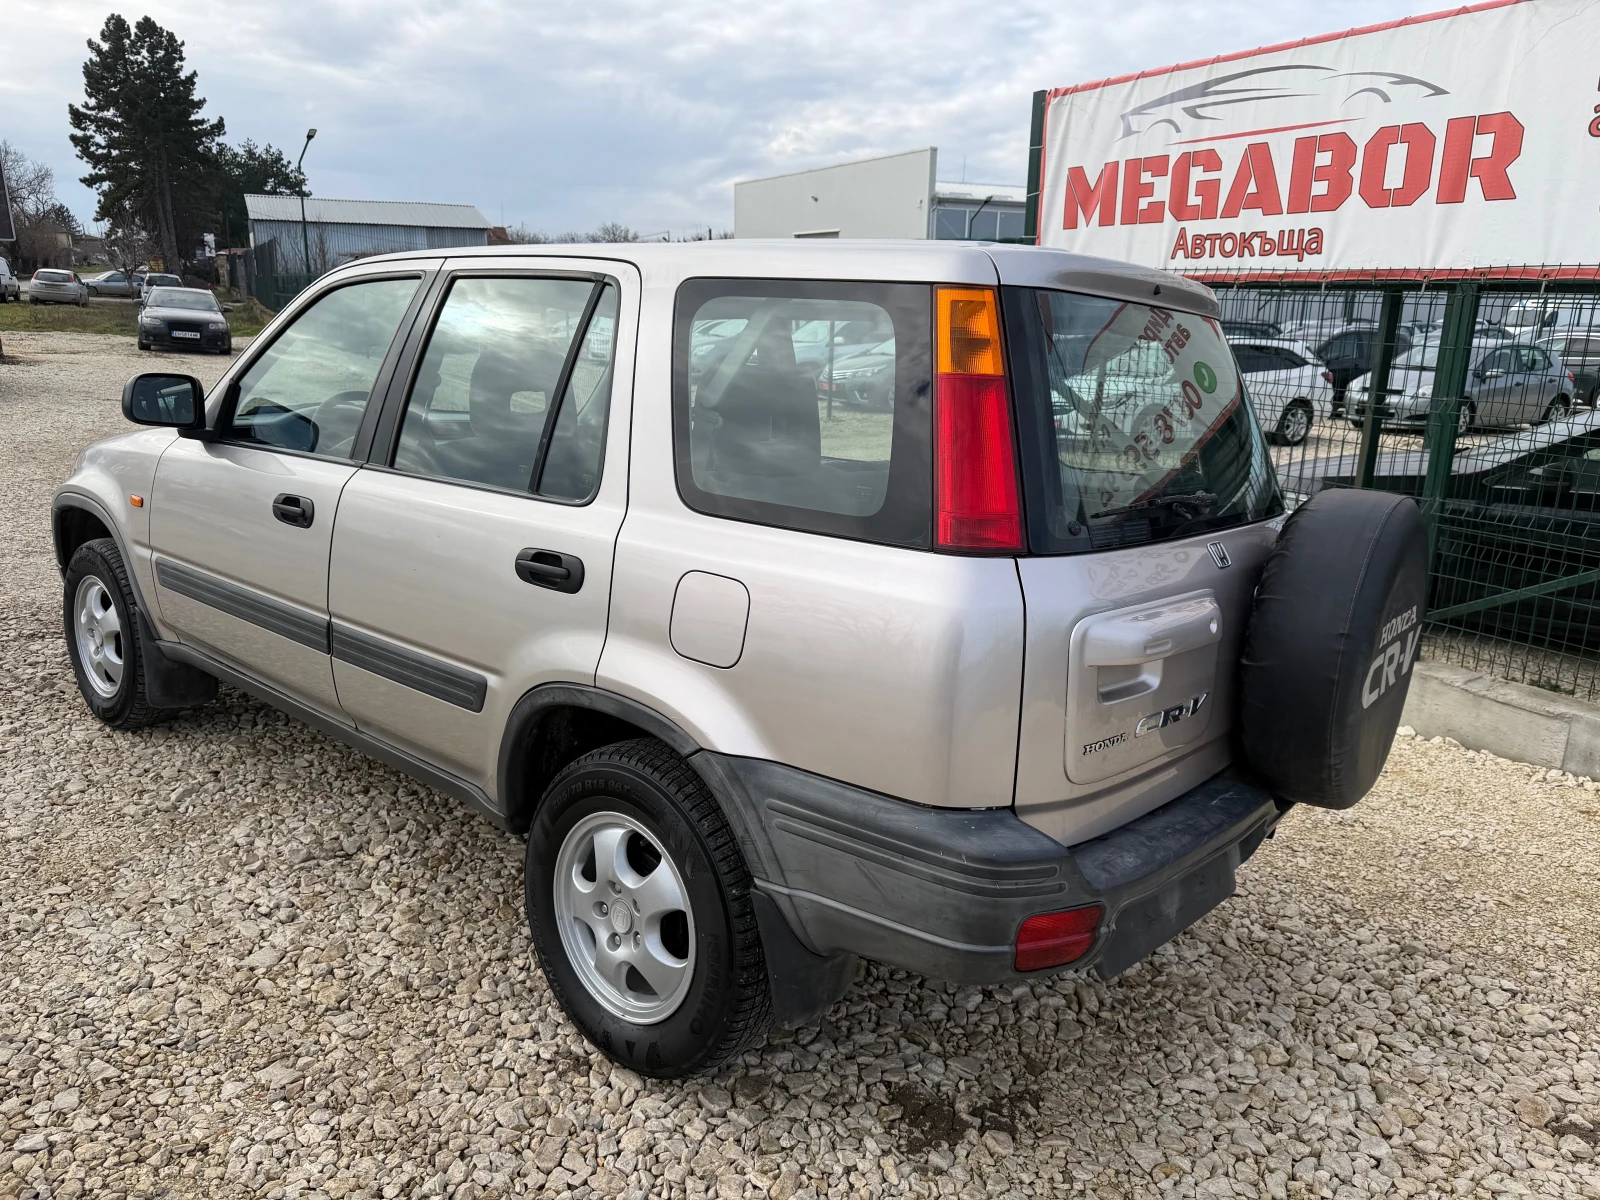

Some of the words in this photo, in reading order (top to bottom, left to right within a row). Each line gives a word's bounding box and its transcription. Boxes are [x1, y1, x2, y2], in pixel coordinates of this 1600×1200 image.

[1062, 111, 1524, 230] MEGABOR
[1171, 227, 1324, 262] Автокъща
[1362, 624, 1422, 709] CR-V
[1083, 732, 1129, 755] HONDA
[1134, 691, 1210, 738] CR-V
[584, 779, 605, 790] R15
